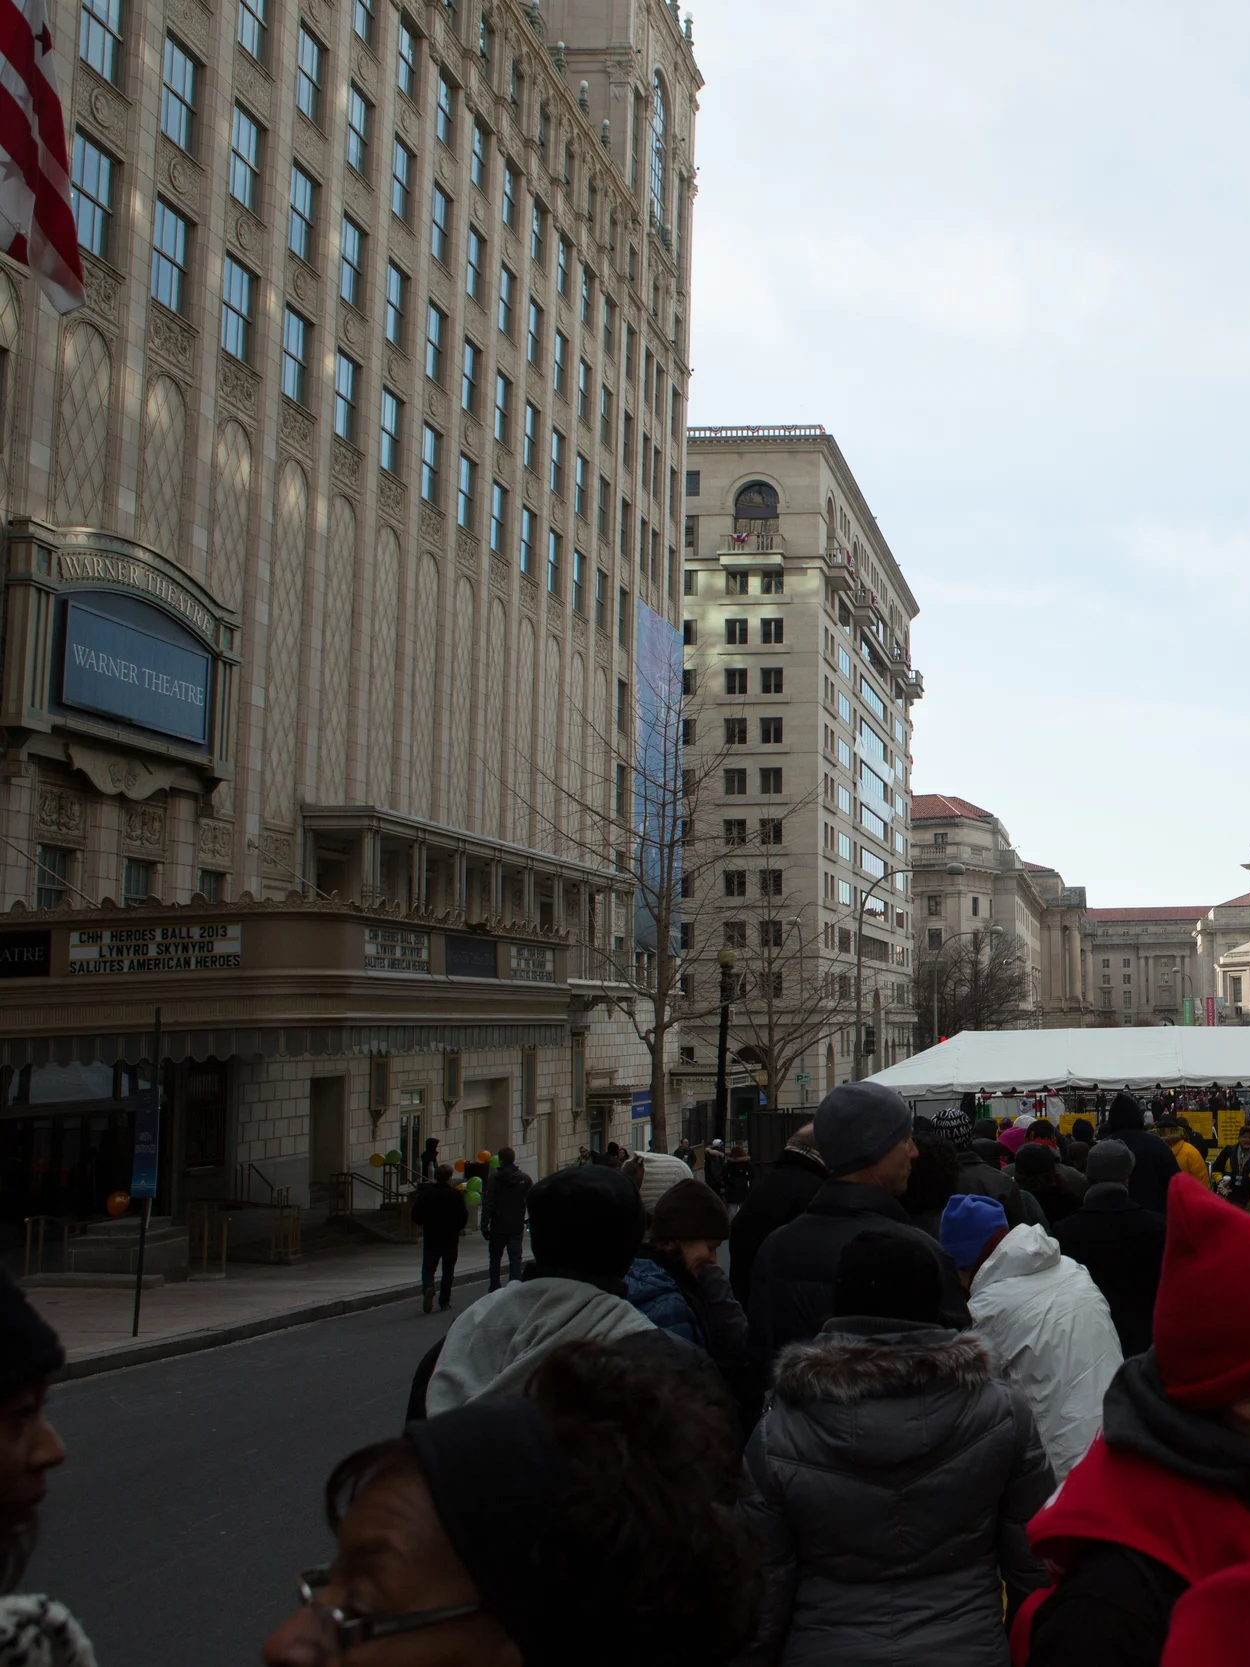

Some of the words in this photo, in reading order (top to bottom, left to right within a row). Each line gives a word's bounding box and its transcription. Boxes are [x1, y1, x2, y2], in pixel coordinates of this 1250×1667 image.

[64, 555, 139, 586] WARNER
[145, 570, 213, 635] THEATRE
[73, 644, 139, 685] WARNER
[142, 667, 204, 706] THEATRE
[79, 931, 103, 944] CHH
[110, 929, 156, 943] HEROES
[161, 927, 193, 940] BALL
[199, 926, 228, 939] 2013
[0, 946, 45, 962] ATRE
[99, 944, 149, 958] LYNYRD
[156, 941, 213, 955] SKYNYRD
[69, 959, 123, 974] SALUTES
[128, 957, 191, 972] AMERICAN
[195, 955, 241, 968] HEROES
